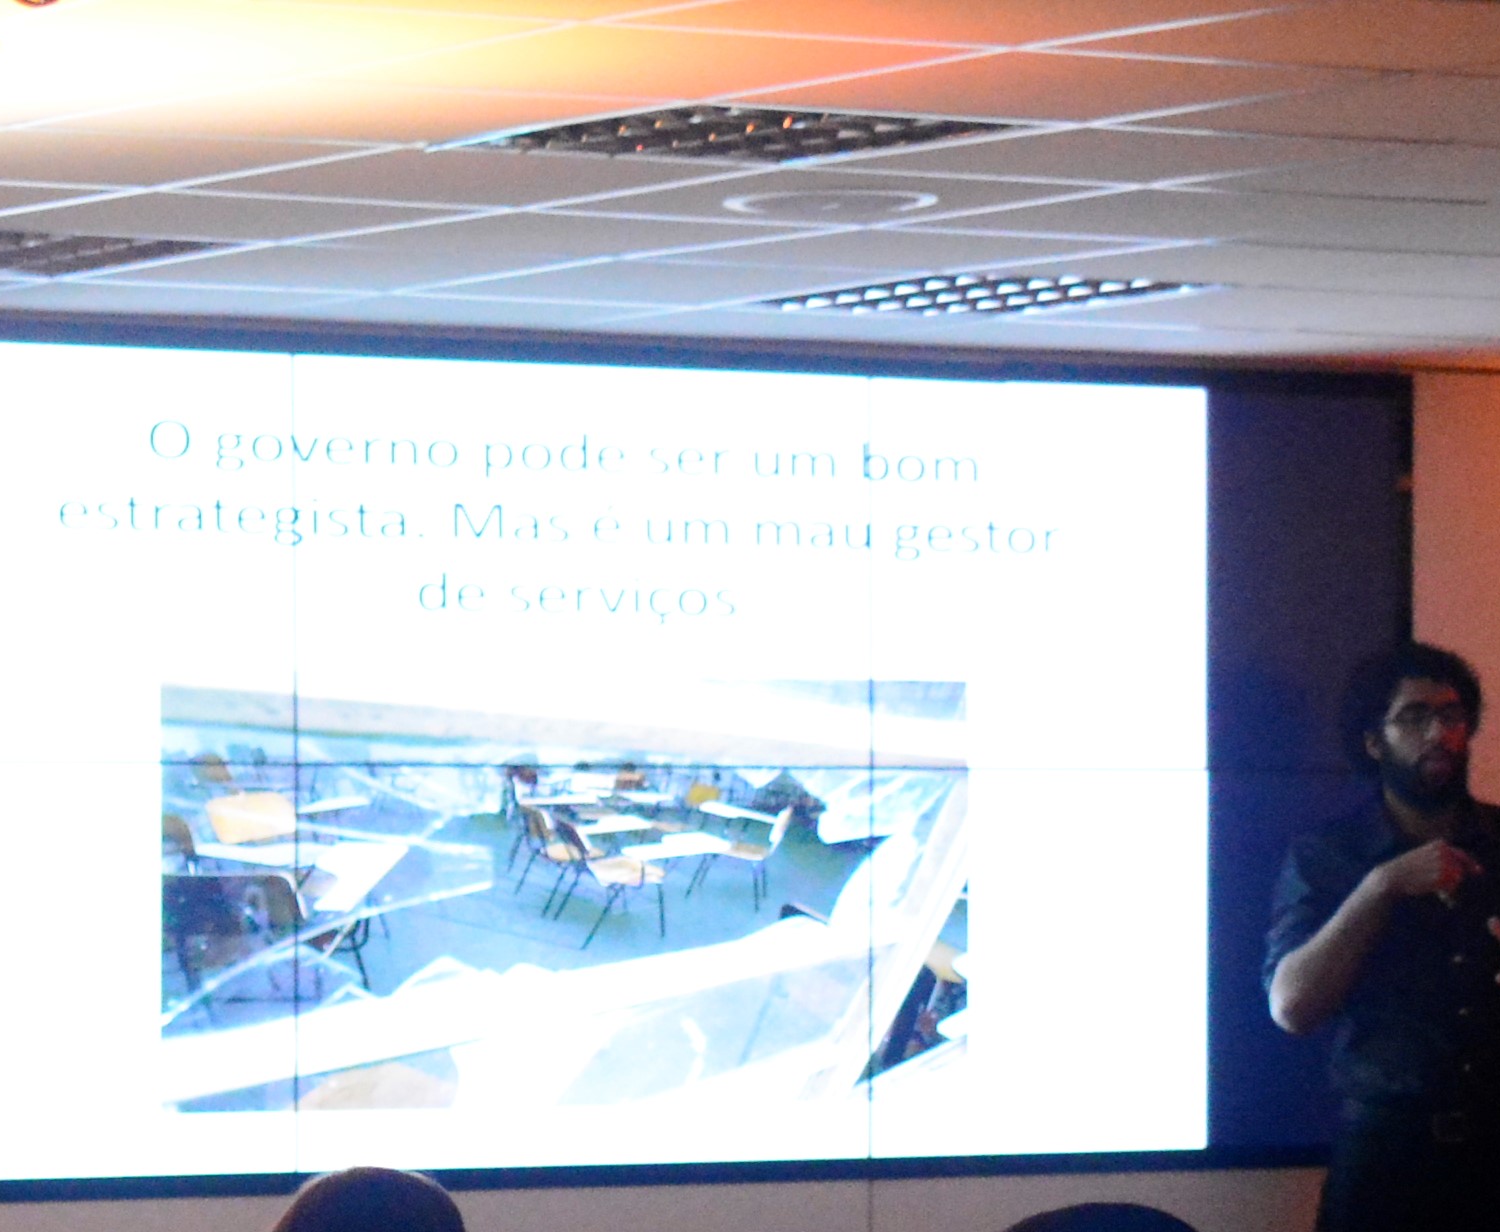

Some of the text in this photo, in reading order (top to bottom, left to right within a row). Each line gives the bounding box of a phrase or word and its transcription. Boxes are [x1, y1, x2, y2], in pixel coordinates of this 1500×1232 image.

[148, 419, 979, 483] O governo pode ser um bom
[58, 496, 1062, 561] estrategista. Mas é um mau gestor
[418, 571, 737, 625] de serviços
